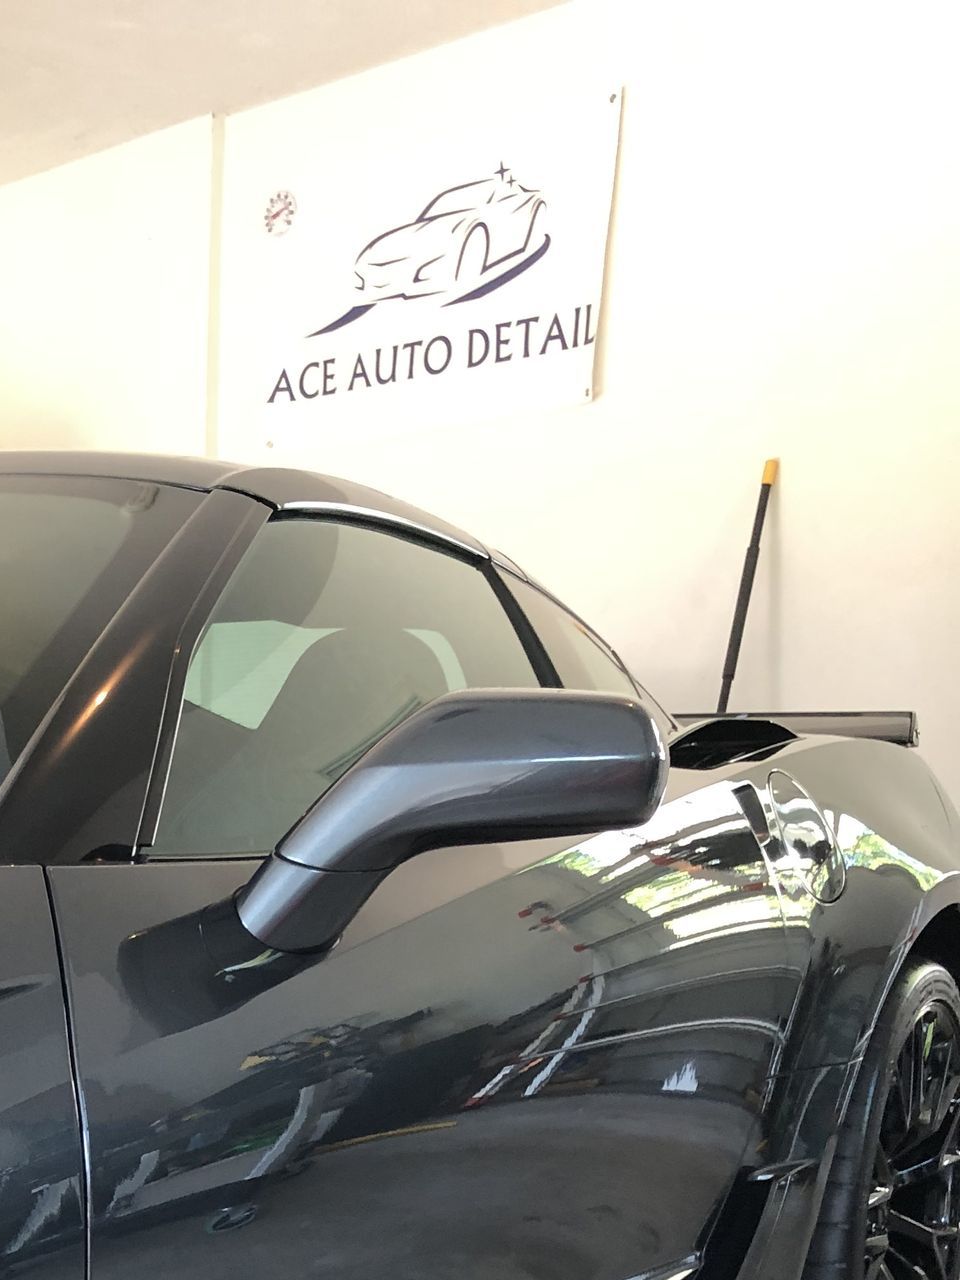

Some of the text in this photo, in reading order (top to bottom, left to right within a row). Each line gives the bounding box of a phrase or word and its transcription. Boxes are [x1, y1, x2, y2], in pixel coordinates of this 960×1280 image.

[266, 303, 595, 404] ACE AUTO DETAIL
